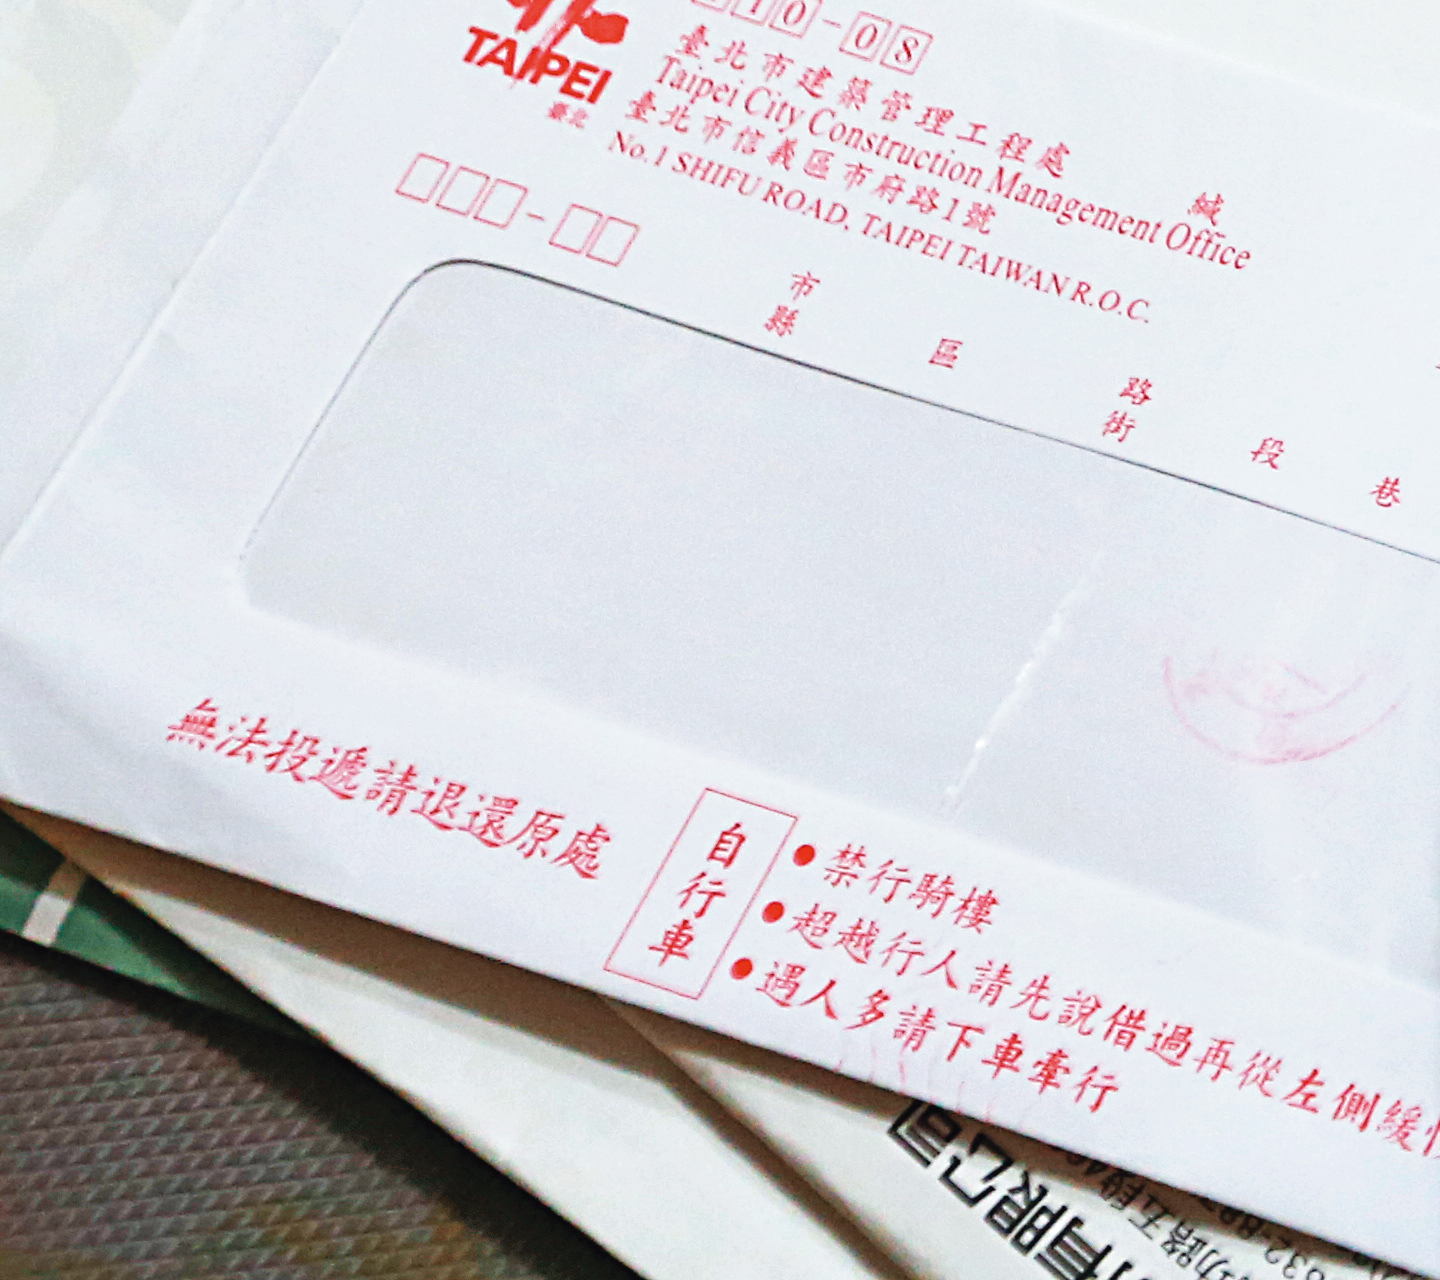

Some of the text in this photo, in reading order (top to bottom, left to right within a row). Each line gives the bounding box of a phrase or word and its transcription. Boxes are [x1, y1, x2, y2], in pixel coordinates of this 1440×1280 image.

[462, 25, 615, 106] TAIPEI
[674, 22, 1071, 180] 臺北市建築管理工程處
[625, 90, 998, 238] 臺北市信義區市府路1號
[653, 52, 1253, 272] Taipei City Construction Management Office
[671, 149, 764, 198] SHIFU
[860, 212, 956, 264] TAIPEI
[956, 243, 1078, 298] TAIWAN
[1069, 276, 1151, 325] R.O.C.
[1250, 436, 1286, 472] 段
[1369, 476, 1402, 509] 巷
[165, 697, 612, 880] 無法投遞請退還原處
[648, 821, 747, 968] 自行車
[822, 843, 1000, 935] 禁行騎樓
